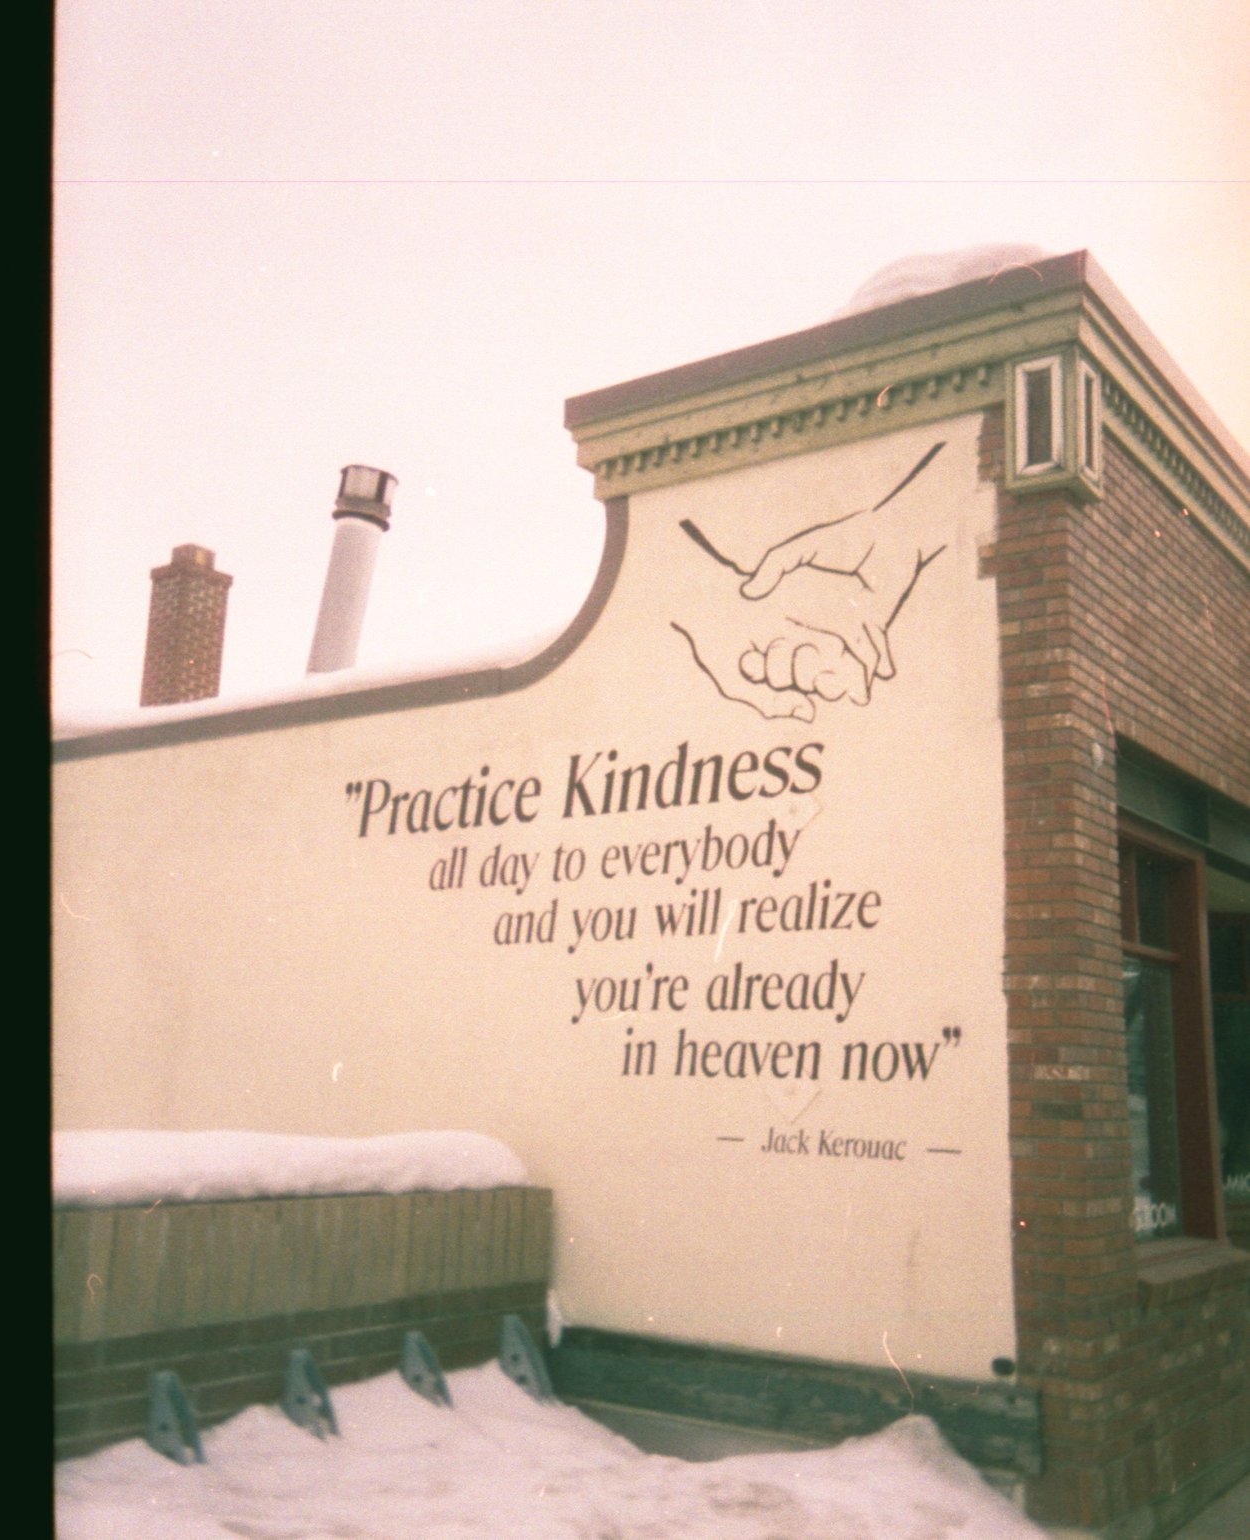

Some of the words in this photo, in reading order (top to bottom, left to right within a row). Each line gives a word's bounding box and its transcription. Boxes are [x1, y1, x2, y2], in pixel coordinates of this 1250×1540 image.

[562, 740, 826, 819] Kindness
[428, 846, 468, 891] all
[478, 843, 541, 896] day
[552, 845, 587, 883] to
[600, 818, 802, 886] everybody
[493, 898, 559, 946] and
[567, 906, 637, 955] you
[654, 888, 722, 938] will
[737, 878, 882, 935] realize
[571, 961, 690, 1025] you're
[706, 958, 866, 1024] already
[621, 1026, 657, 1077] in
[674, 1028, 822, 1081] heaven
[761, 1127, 810, 1156] Jack
[817, 1129, 908, 1161] Kerouac
